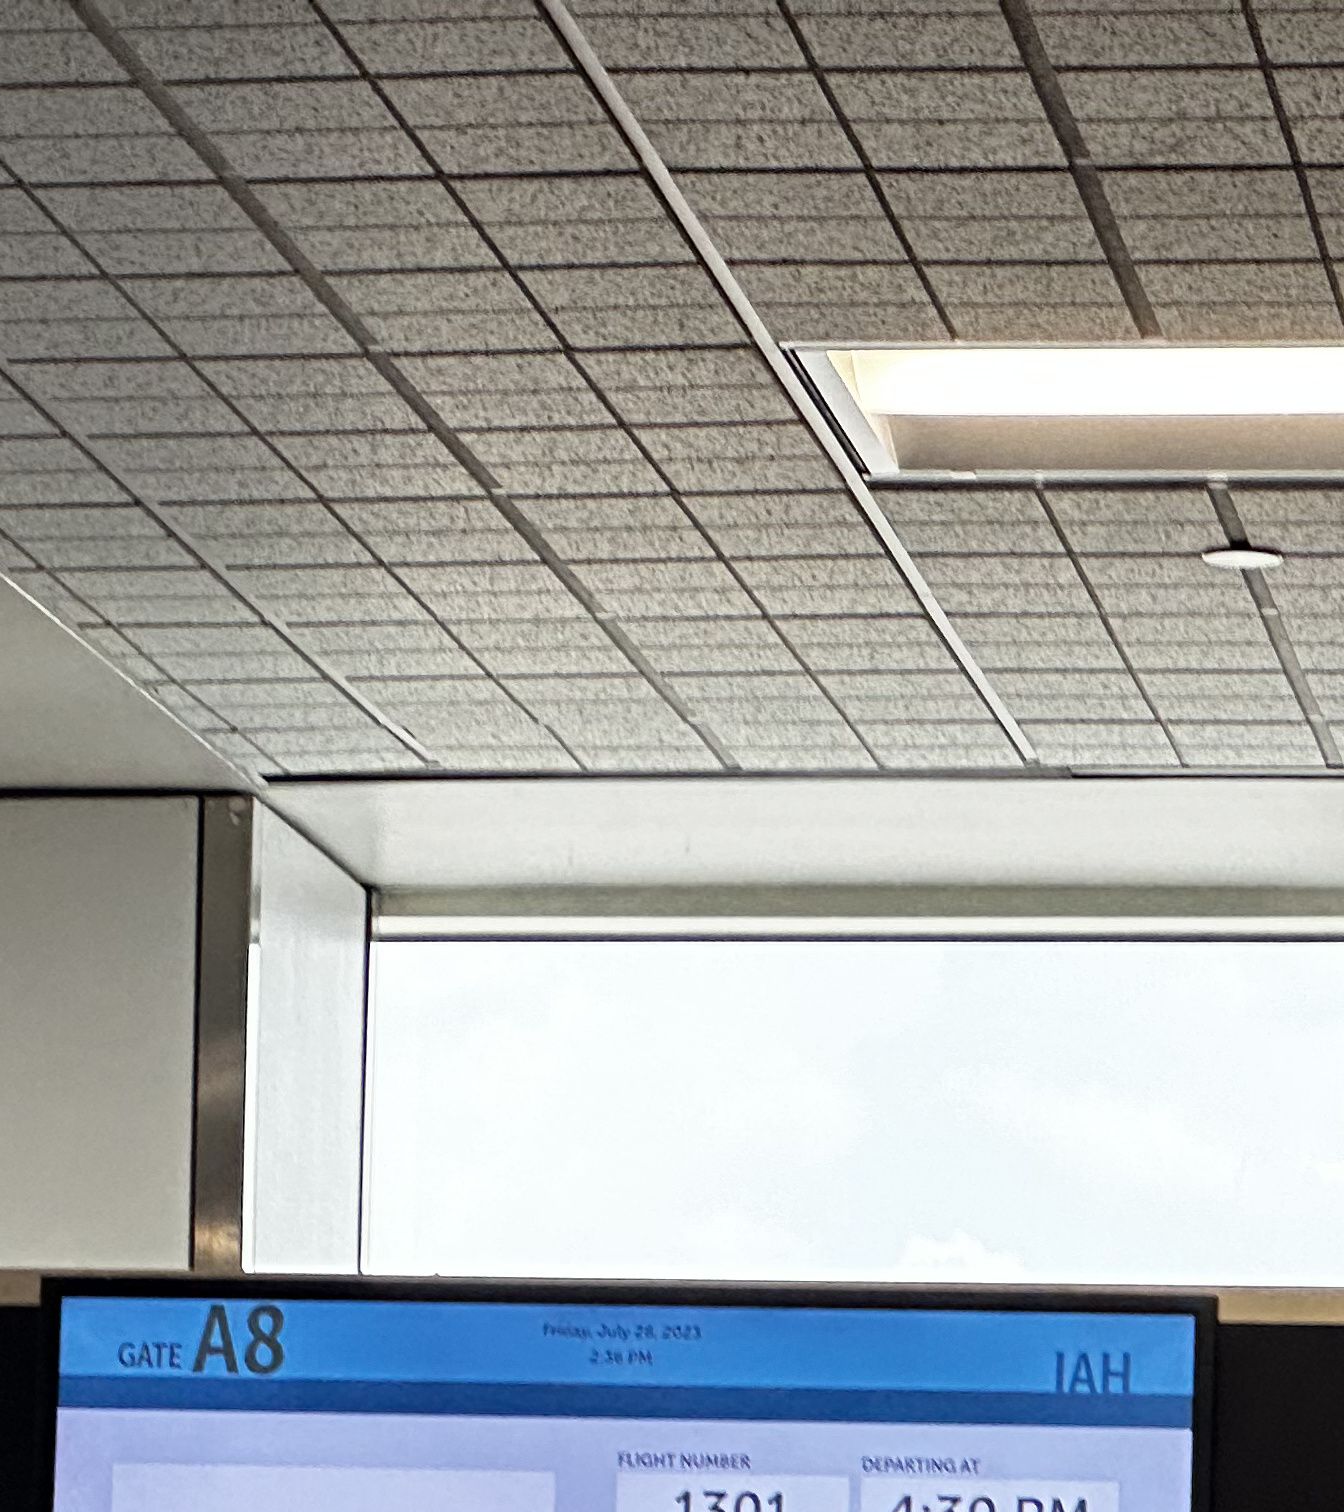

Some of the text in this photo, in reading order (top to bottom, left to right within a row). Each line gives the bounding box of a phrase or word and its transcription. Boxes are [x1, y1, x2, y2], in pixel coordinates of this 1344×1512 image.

[118, 1304, 284, 1374] GATE A8
[597, 1323, 630, 1341] July
[662, 1325, 702, 1340] 2023
[627, 1350, 654, 1366] PM
[1056, 1352, 1130, 1394] IAH
[617, 1451, 751, 1470] FLIGHT NUMBER
[860, 1455, 981, 1475] DEPARTING AT
